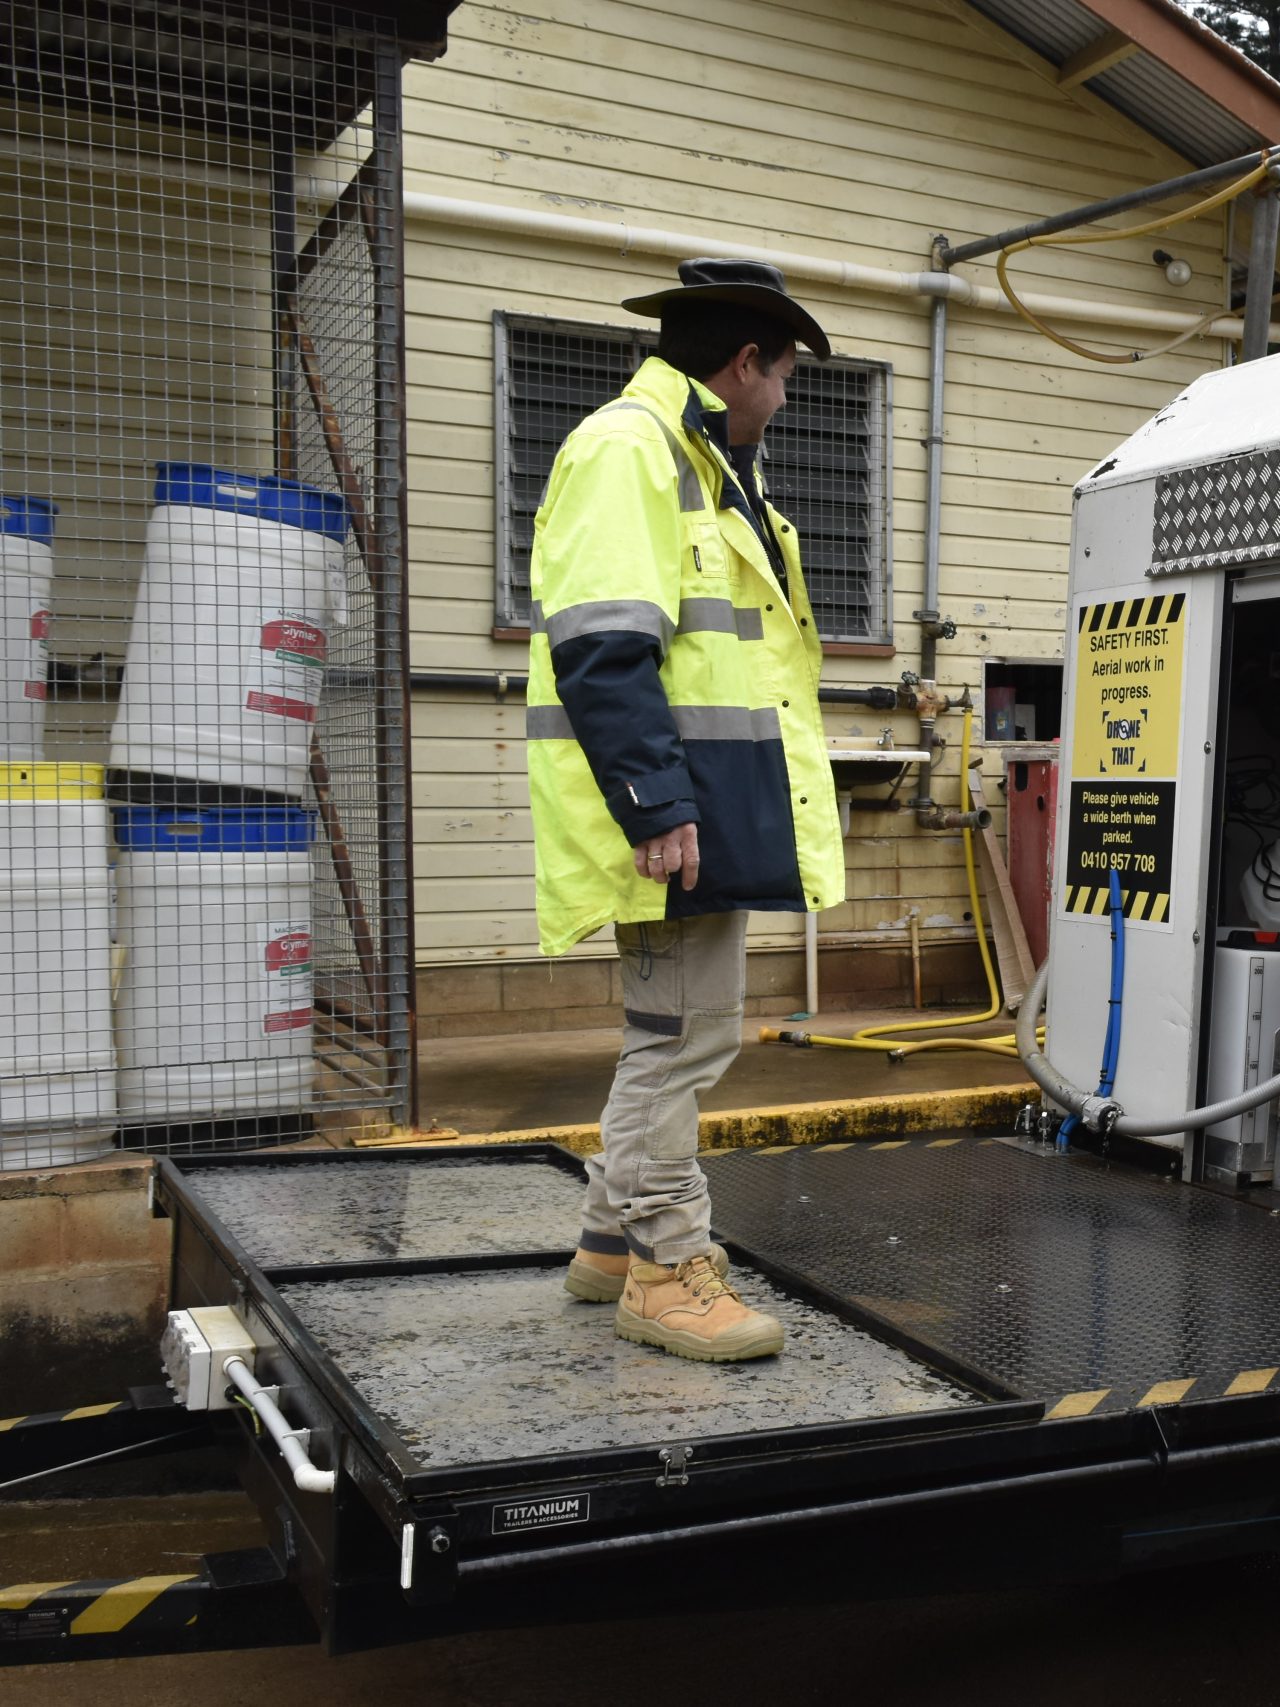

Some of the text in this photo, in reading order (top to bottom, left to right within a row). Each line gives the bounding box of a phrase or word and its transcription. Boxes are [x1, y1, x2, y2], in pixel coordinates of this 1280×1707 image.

[1090, 628, 1169, 653] SAFETY FIRST.
[1092, 655, 1164, 677] Aerial work in
[1101, 684, 1151, 705] progress.
[1106, 718, 1141, 741] DRONE
[1111, 747, 1136, 766] THAT
[1082, 791, 1160, 808] Please give vehicle
[1083, 811, 1156, 825] a wide berth when
[1102, 830, 1133, 845] parked.
[1081, 851, 1155, 873] 0410 957 708
[503, 1499, 579, 1521] TITANIUM
[538, 1512, 579, 1523] ACCESSORIES
